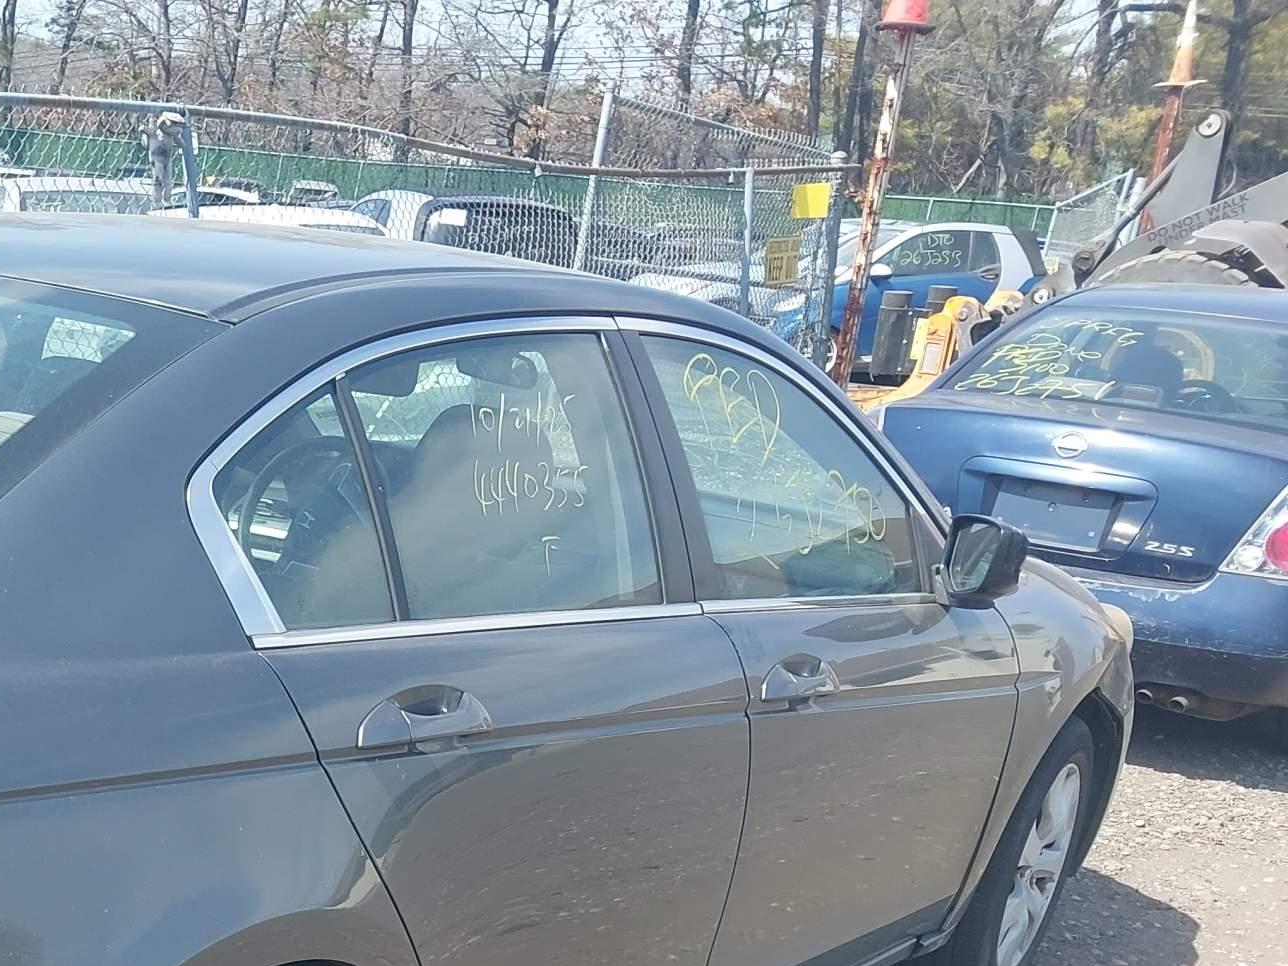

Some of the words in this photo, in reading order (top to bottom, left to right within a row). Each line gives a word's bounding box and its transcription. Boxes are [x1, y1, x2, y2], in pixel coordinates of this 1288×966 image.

[1147, 229, 1168, 242] DO
[1172, 211, 1201, 230] NOT
[1207, 194, 1248, 216] WALK
[1209, 204, 1247, 221] MAST
